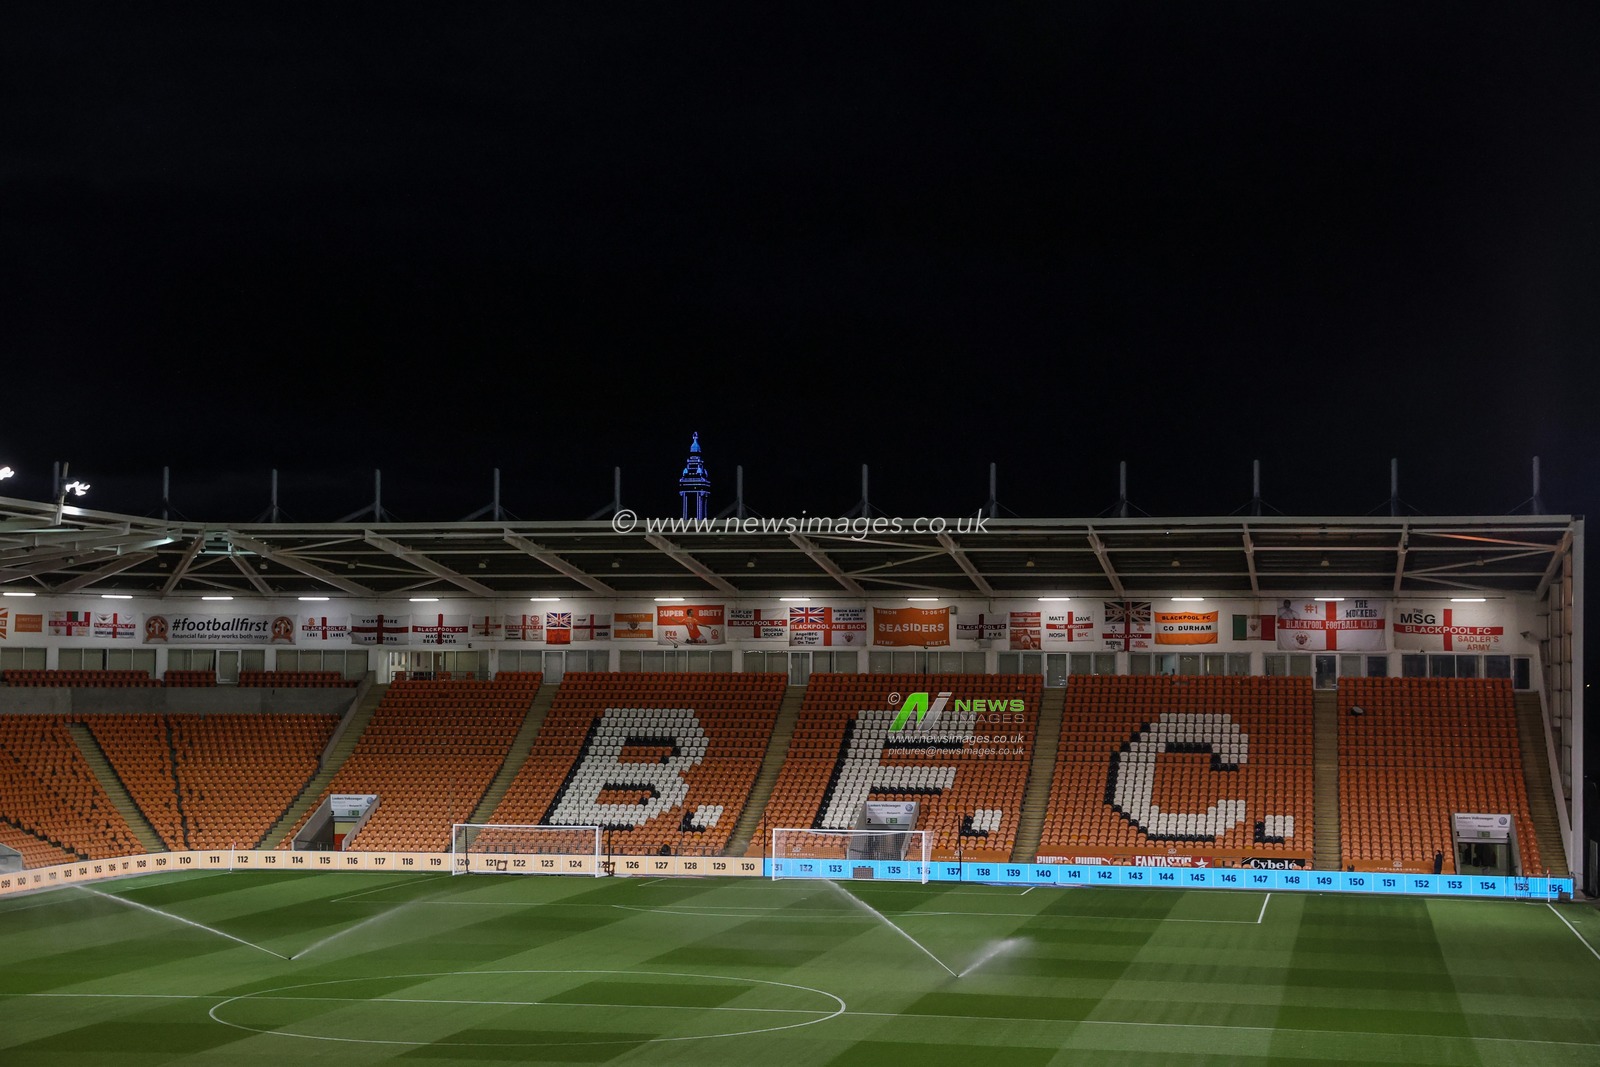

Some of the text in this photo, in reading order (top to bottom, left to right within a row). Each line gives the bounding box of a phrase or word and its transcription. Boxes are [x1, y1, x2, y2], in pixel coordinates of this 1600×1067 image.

[1354, 600, 1368, 608] THE
[1304, 604, 1318, 614] #1
[1346, 610, 1378, 618] MUCKERS
[1400, 614, 1436, 624] MSG
[172, 618, 268, 631] #footballfirst
[879, 623, 944, 632] SEASIDERS
[1286, 620, 1378, 629] BLACKPOOL FOOTBALL CLUB
[1405, 626, 1473, 634] BLACKPOOL
[156, 858, 167, 867] 109
[237, 855, 249, 864] 112
[319, 856, 331, 865] 115
[402, 857, 414, 866] 118
[541, 859, 554, 868] 123
[108, 863, 116, 873] 106
[136, 860, 147, 869] 108
[655, 861, 669, 870] 127
[713, 862, 727, 871] 129
[829, 864, 843, 873] 133
[64, 869, 72, 879] 103
[78, 867, 87, 876] 104
[94, 865, 102, 874] 105
[1007, 868, 1021, 877] 139
[1036, 869, 1052, 878] 140
[1128, 871, 1143, 880] 143
[1158, 872, 1174, 881] 144
[1190, 873, 1206, 882] 145
[1221, 874, 1237, 883] 146
[1285, 875, 1300, 884] 148
[1, 879, 11, 890] 099
[17, 877, 27, 887] 100
[1316, 876, 1332, 885] 149
[1349, 877, 1365, 886] 150
[1383, 878, 1396, 887] 151
[1414, 879, 1430, 888] 152
[1447, 880, 1463, 889] 153
[1480, 881, 1496, 890] 154
